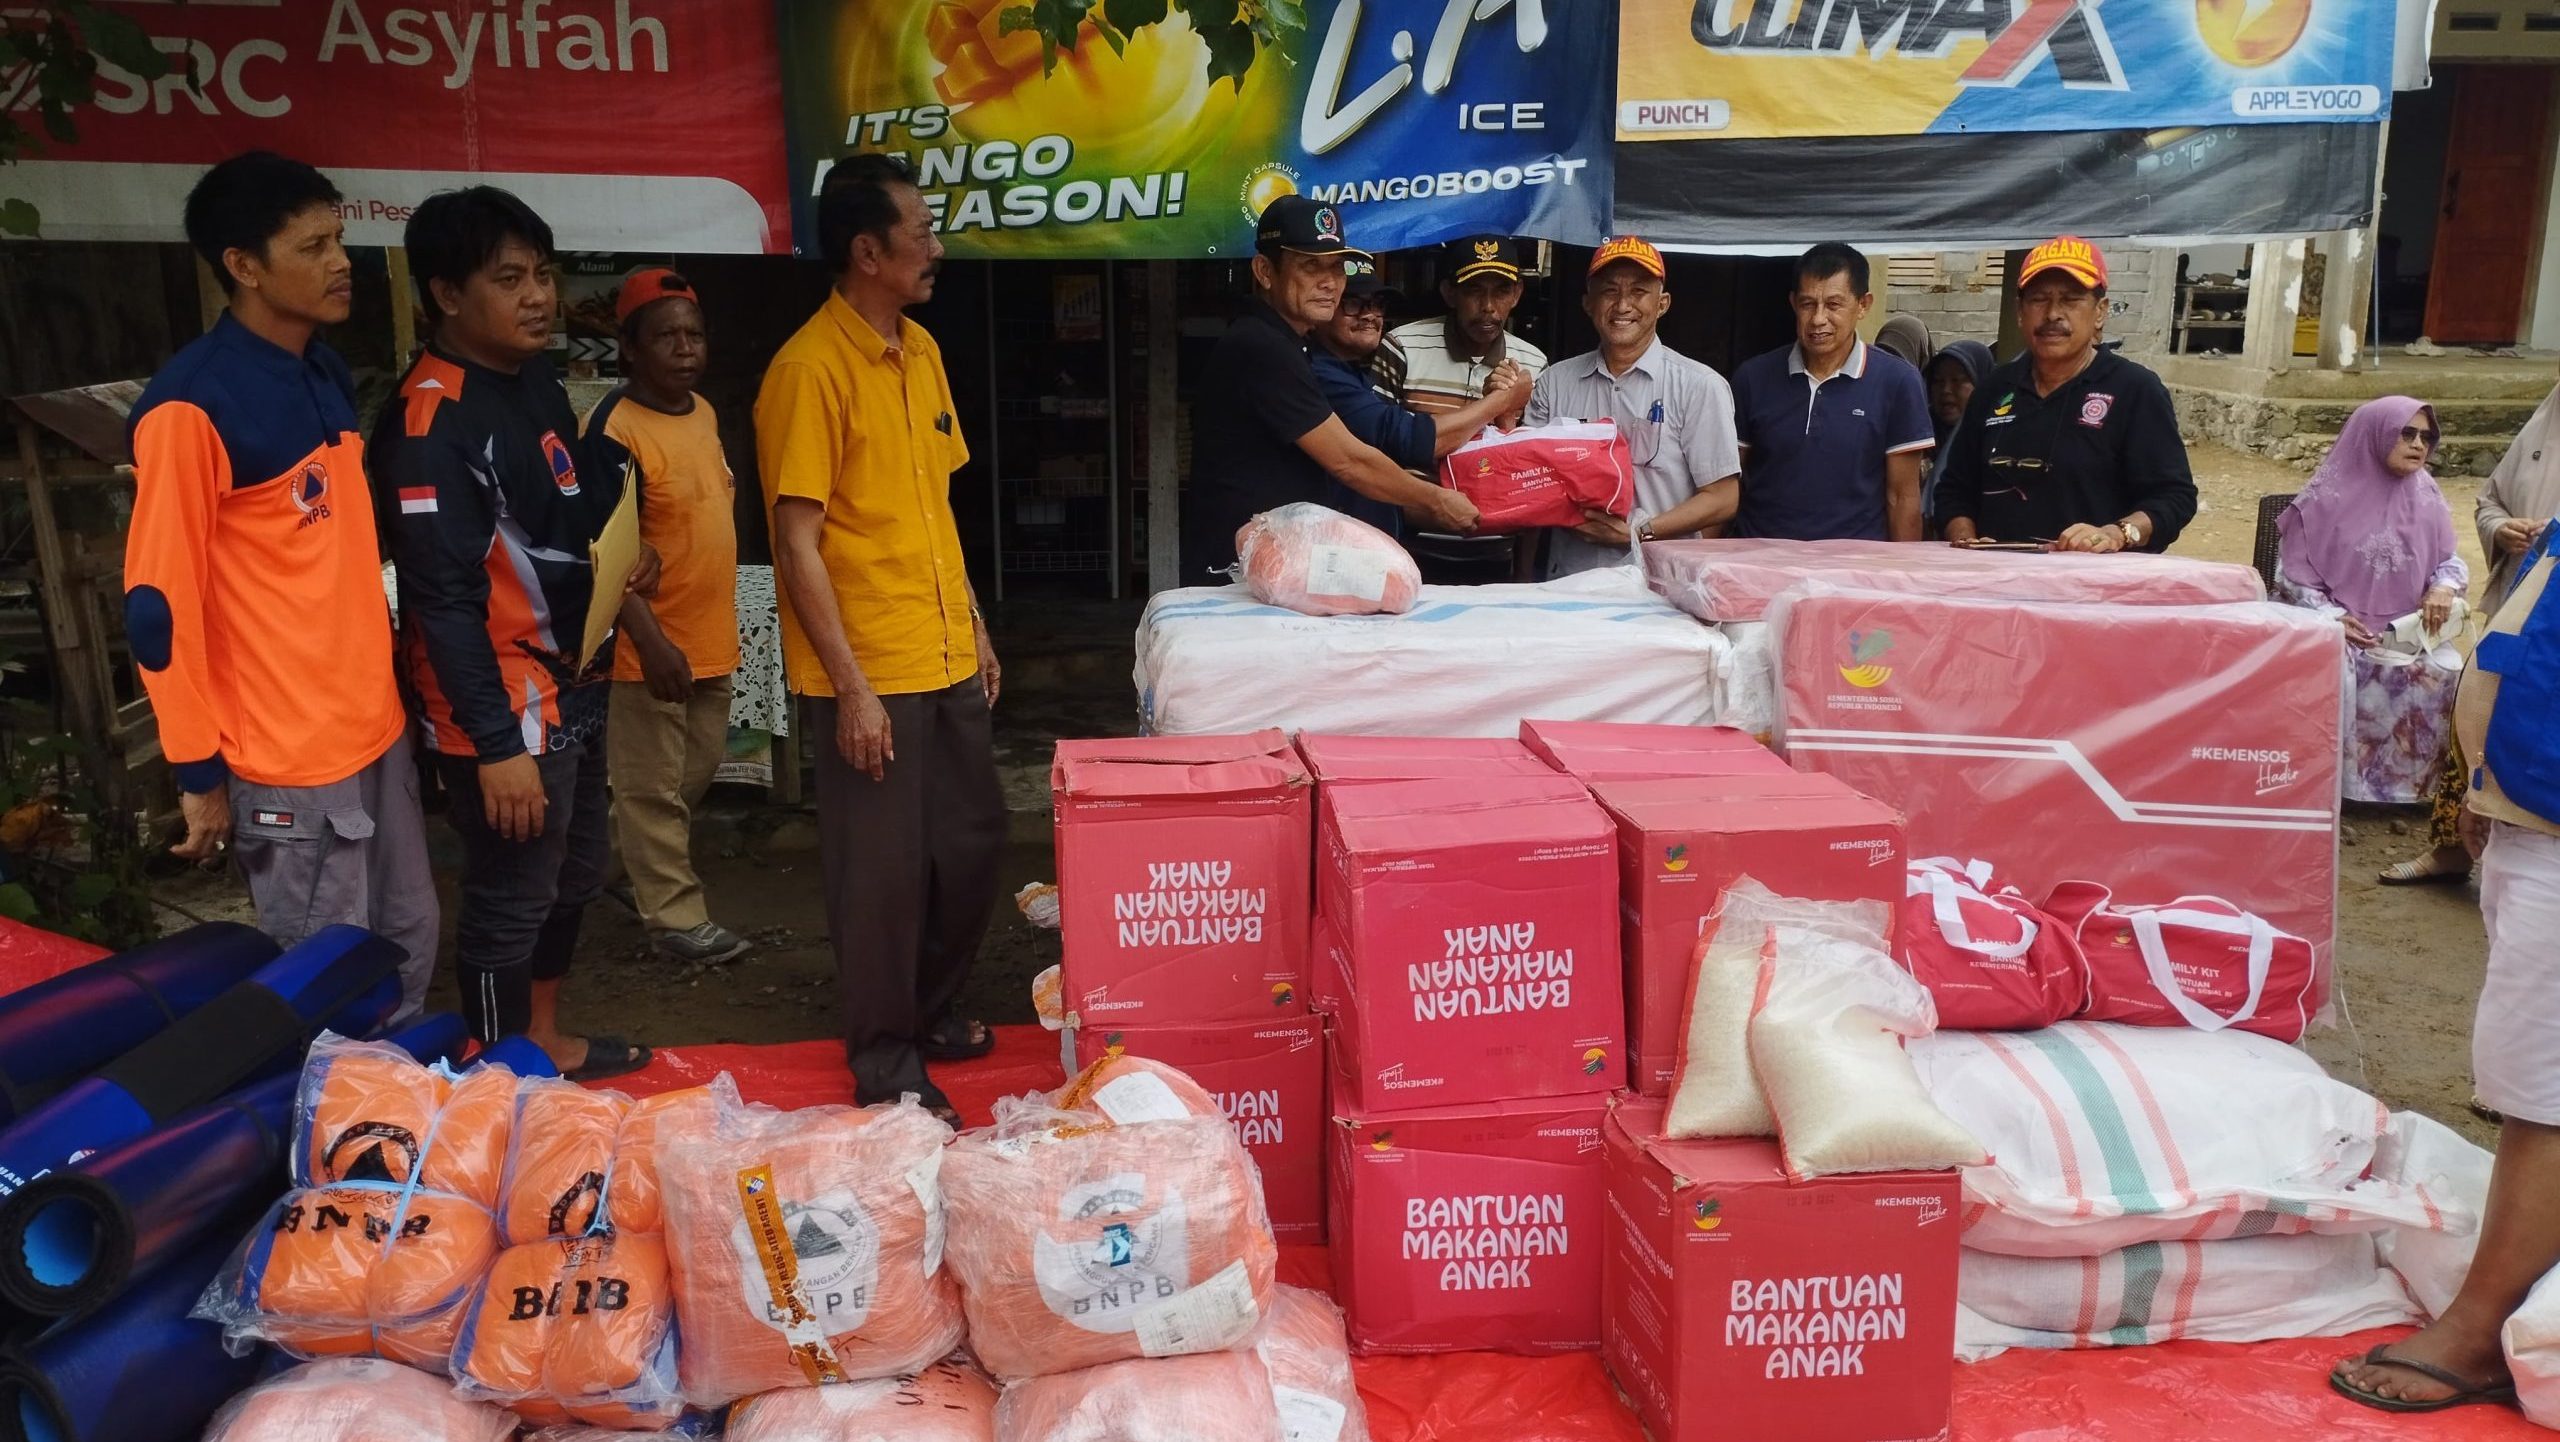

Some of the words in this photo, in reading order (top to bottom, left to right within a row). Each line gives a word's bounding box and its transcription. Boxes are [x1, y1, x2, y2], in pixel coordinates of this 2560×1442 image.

[317, 0, 669, 89] Asyifah
[1638, 104, 1709, 125] PUNCH
[2249, 90, 2362, 111] APPLEYOGO
[844, 104, 950, 146] IT'S
[1458, 102, 1546, 131] ICE
[811, 134, 1072, 197] NGO
[1254, 162, 1301, 180] CAPSULE
[1310, 158, 1588, 205] MANGOBOOST
[929, 171, 1187, 233] EASON!
[1601, 237, 1658, 260] TAGANA
[2029, 239, 2094, 265] TAGANA
[1510, 467, 1541, 481] FAMILY
[2191, 746, 2291, 764] #KEMENSOS
[2256, 764, 2299, 790] Hadir
[1829, 839, 1890, 851] #KEMENSOS
[1148, 860, 1232, 890] ANAK
[1114, 887, 1266, 920] MAKANAN
[1118, 916, 1262, 948] BANTUAN
[1443, 922, 1536, 958] ANAK
[1408, 949, 1574, 992] MAKANAN
[2176, 977, 2211, 989] ANTUAN
[2200, 966, 2220, 979] KIT
[1088, 1000, 1144, 1011] #KEMENSOS
[1414, 979, 1570, 1022] BANTUAN
[1253, 1028, 1309, 1039] #KEMENSOS
[1383, 1077, 1445, 1090] #KEMENSOS
[1537, 1128, 1599, 1137] #KEMENSOS
[1406, 1194, 1564, 1228] BANTUAN
[1874, 1196, 1941, 1207] #KEMENSOS
[1918, 1205, 1948, 1222] Hadir
[1402, 1226, 1568, 1259] MAKANAN
[1440, 1259, 1531, 1291] ANAK
[1731, 1273, 1902, 1312] BANTUAN
[1725, 1308, 1906, 1346] MAKANAN
[1765, 1344, 1864, 1379] ANAK
